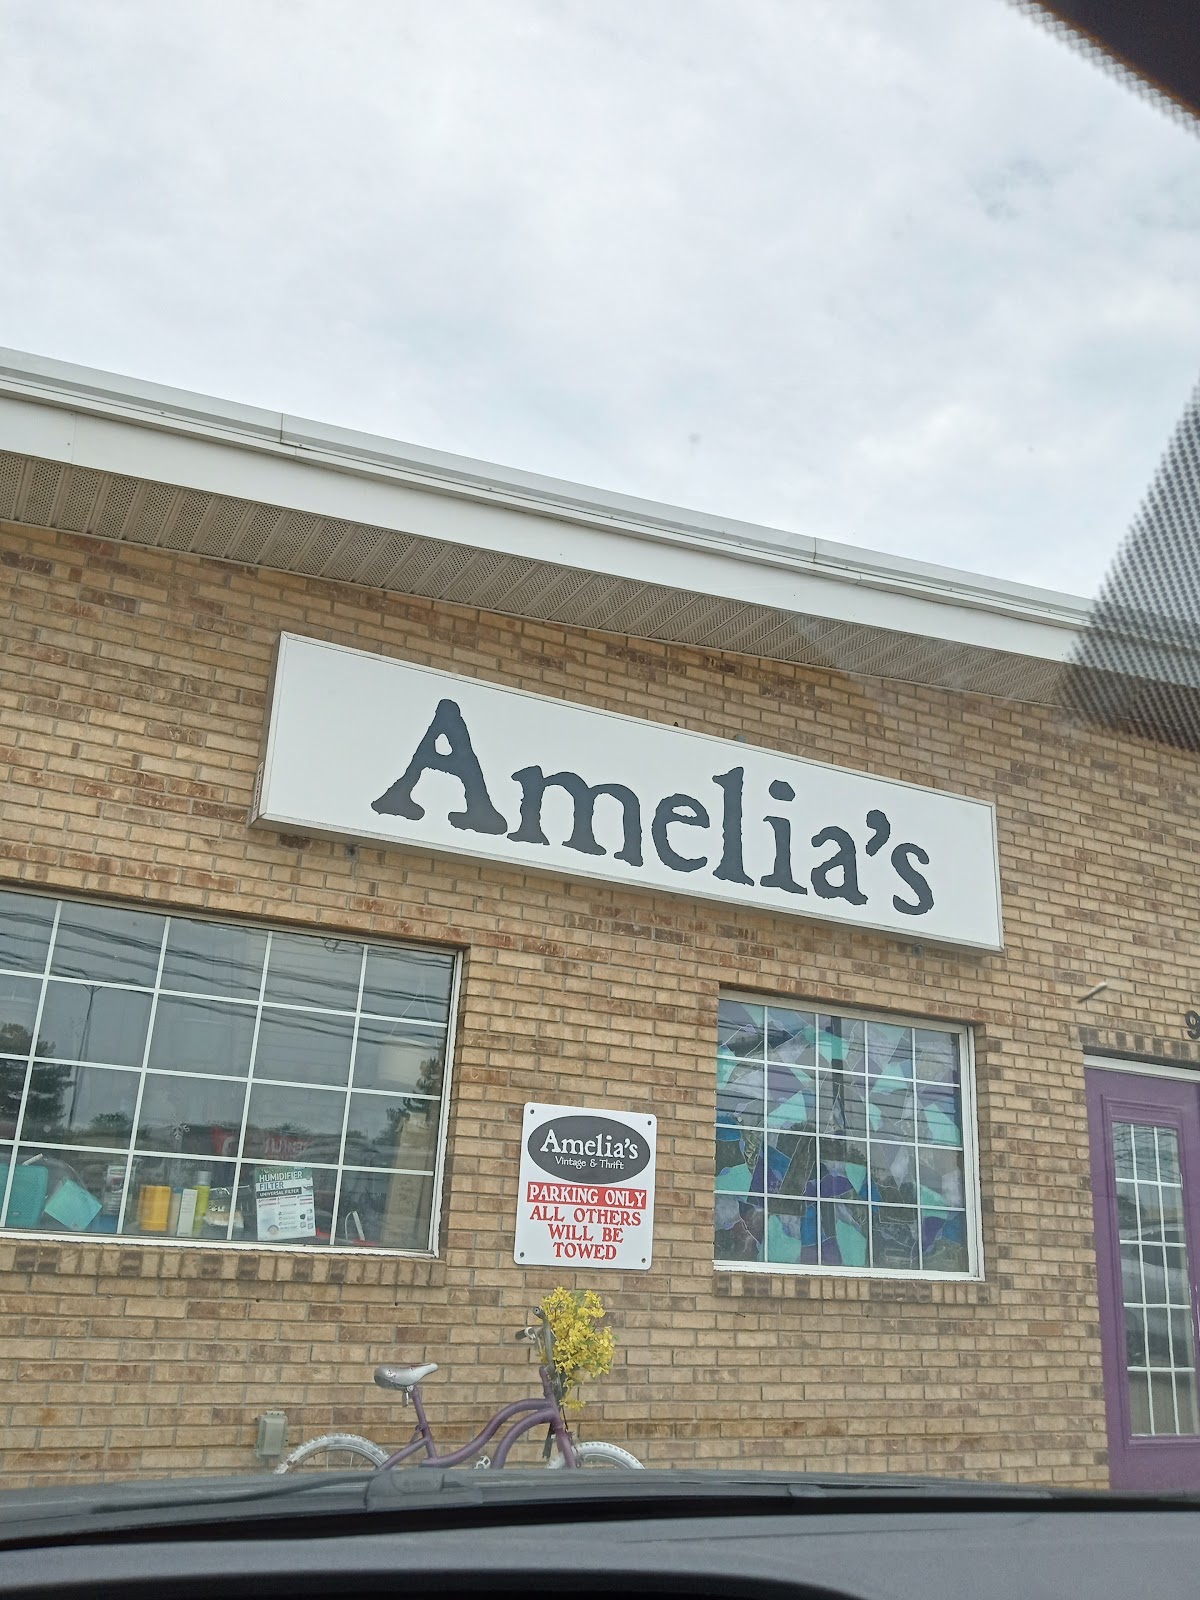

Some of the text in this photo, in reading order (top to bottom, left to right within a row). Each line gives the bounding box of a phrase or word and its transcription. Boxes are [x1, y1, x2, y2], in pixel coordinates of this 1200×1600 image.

[371, 698, 934, 916] Amelia's
[540, 1129, 638, 1160] Amelia's
[555, 1155, 625, 1170] Vintage & Thrift
[259, 1171, 303, 1182] HUMIDIFIER
[260, 1182, 284, 1191] FILTER
[529, 1184, 645, 1207] PARKING ONLY
[529, 1205, 642, 1226] ALL OTHERS
[548, 1223, 624, 1243] WILL BE
[552, 1242, 617, 1260] TOWED
